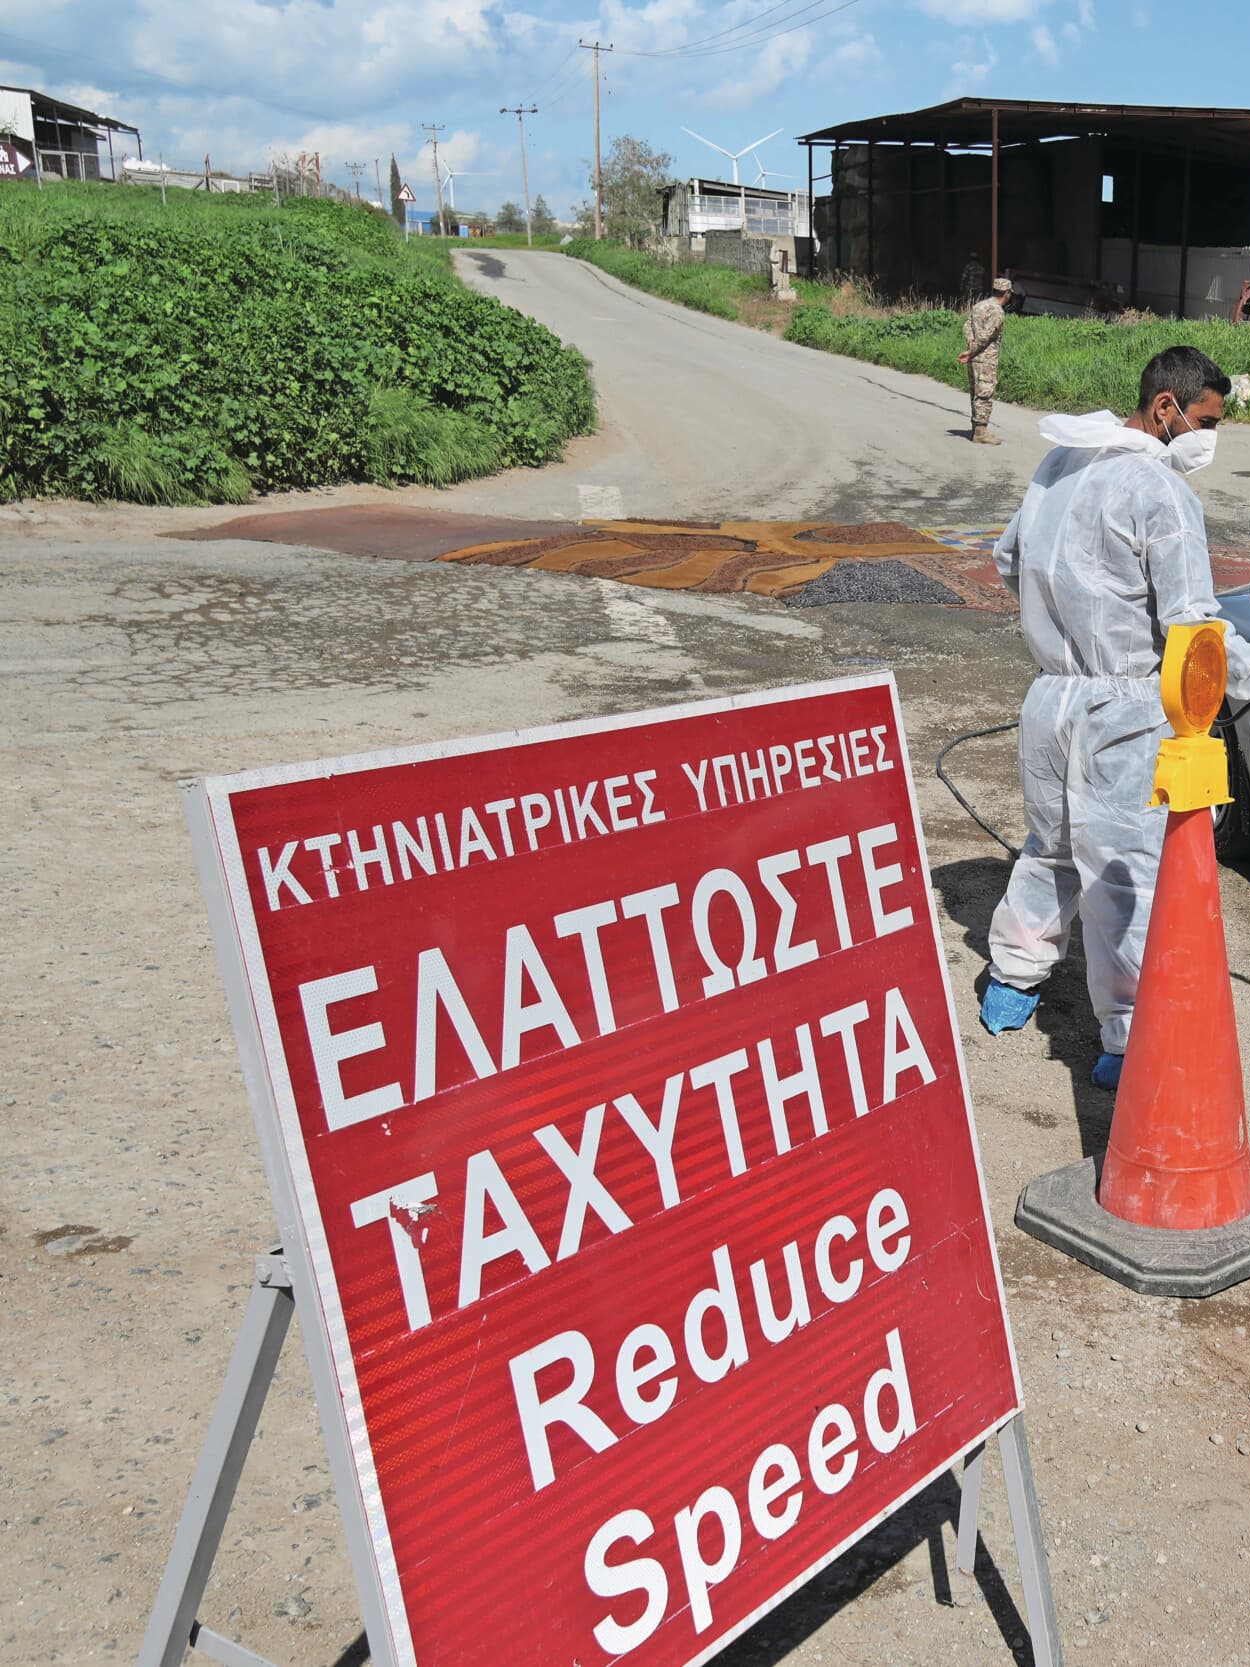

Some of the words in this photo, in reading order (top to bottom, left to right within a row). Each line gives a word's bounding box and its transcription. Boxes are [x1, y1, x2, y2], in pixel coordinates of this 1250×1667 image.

[257, 769, 666, 912] ΚΤΗΝΙΑΤΡΙΚΕΣ
[681, 724, 894, 812] ΥΠΗΡΕΣΙΕΣ
[298, 822, 915, 1133] ΕΛΑΤΤΩΣΤΕ
[349, 986, 938, 1334] ΤΑΧΥΤΗΤΑ
[508, 1187, 912, 1493] Reduce
[582, 1327, 929, 1656] Speed
